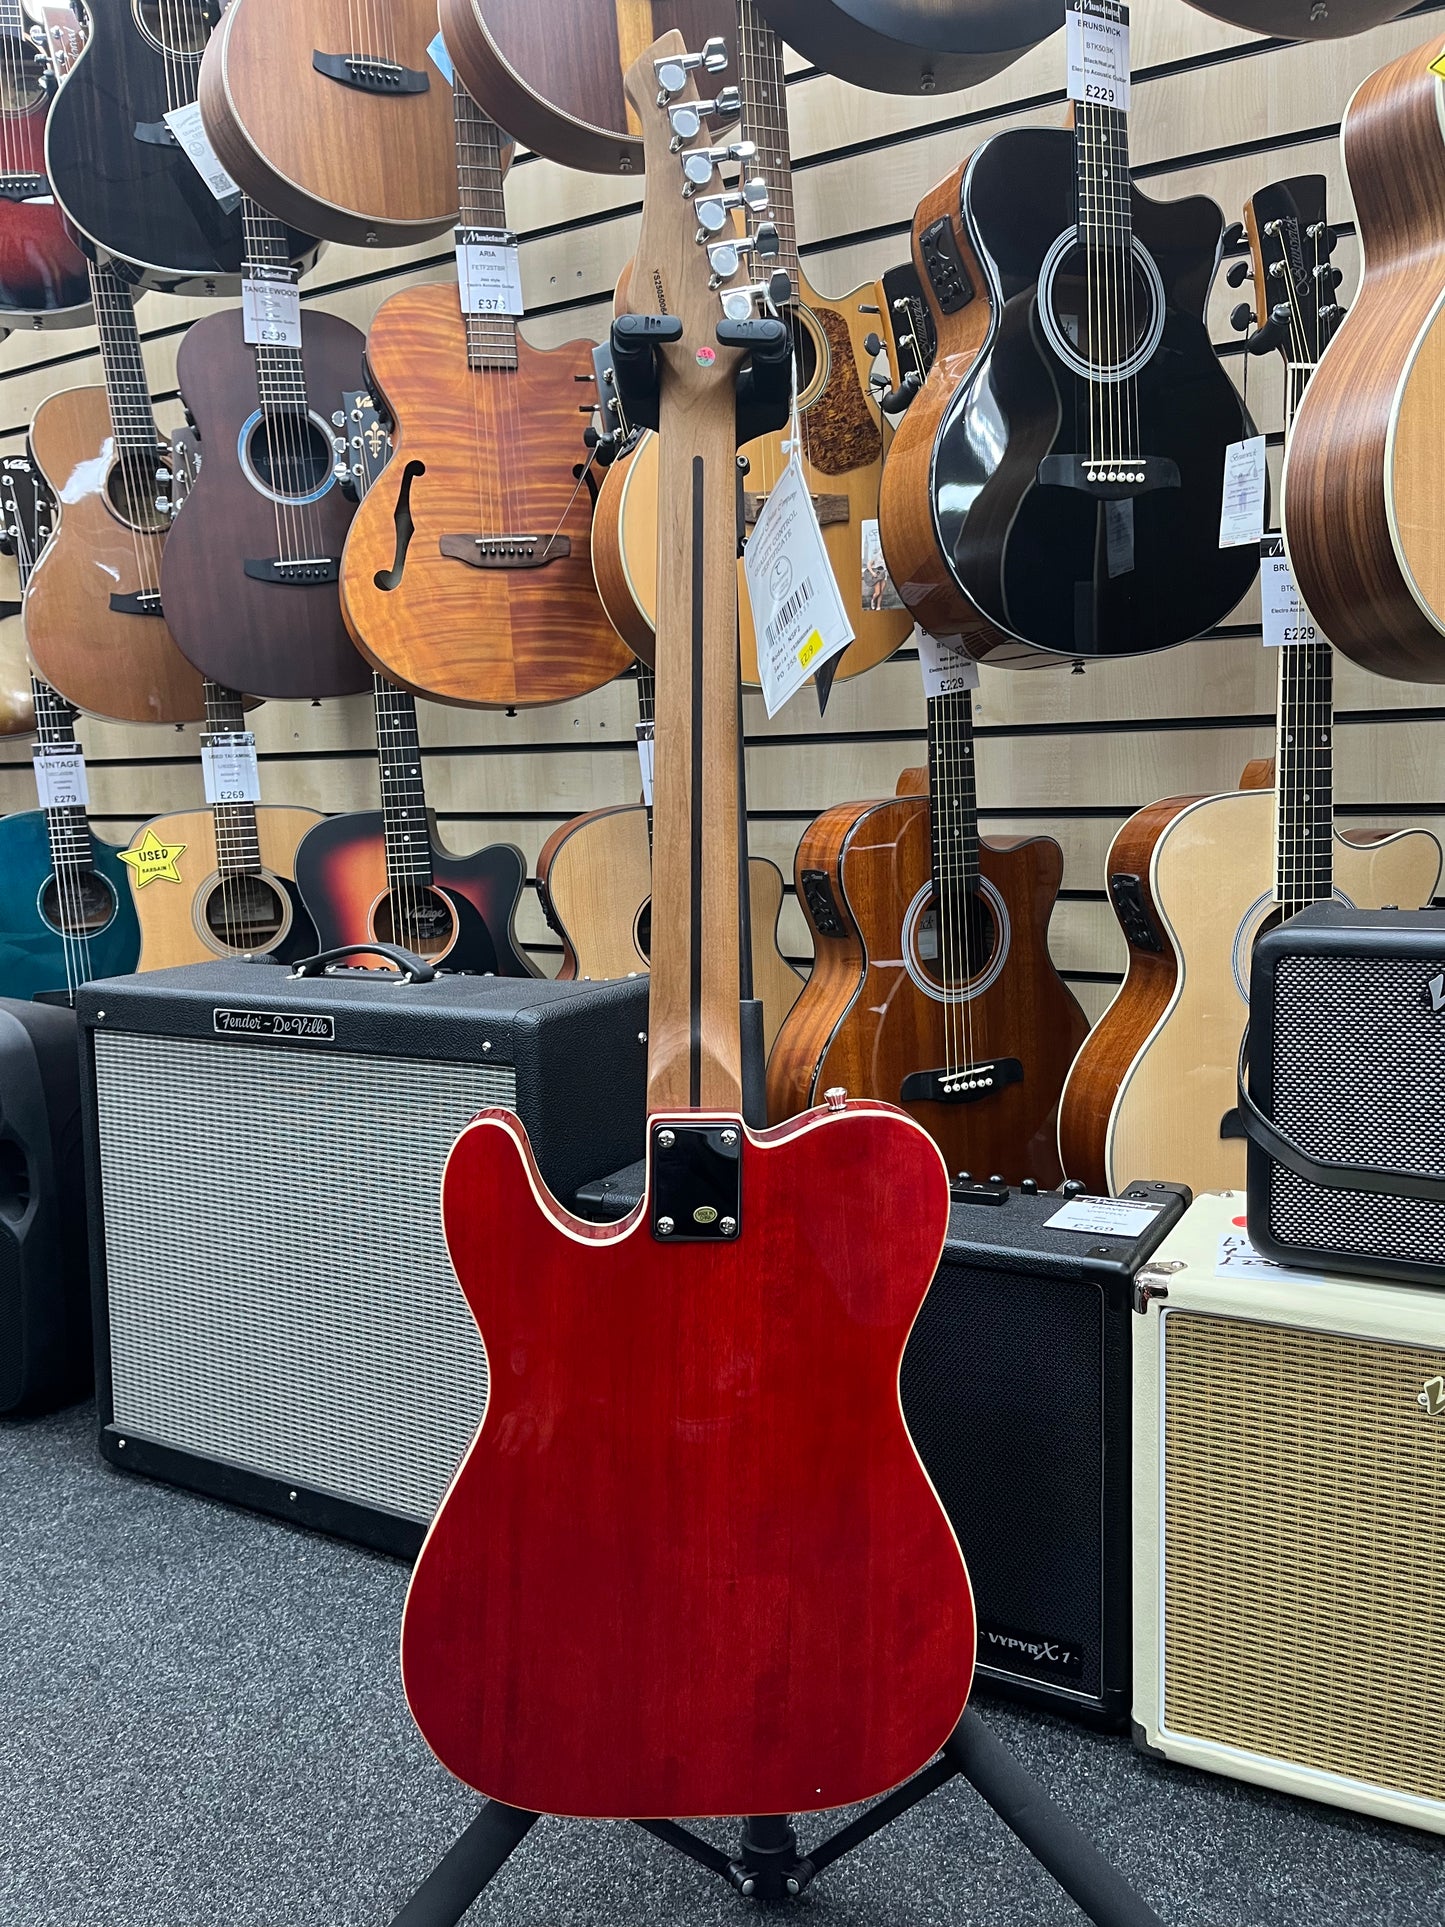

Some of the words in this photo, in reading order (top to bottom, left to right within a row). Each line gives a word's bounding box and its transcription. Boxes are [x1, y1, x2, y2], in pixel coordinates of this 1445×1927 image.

[1077, 19, 1121, 37] BRUNSWICK
[1086, 84, 1115, 102] £229
[244, 286, 298, 297] TANGLEWOOD
[772, 510, 798, 547] CONTROL
[1284, 626, 1315, 640] £229
[940, 677, 965, 692] £229
[40, 760, 80, 769] VINTAGE
[54, 794, 77, 804] £279
[220, 790, 245, 800] £269
[138, 848, 168, 862] USED
[219, 1012, 261, 1030] Fender
[1073, 1223, 1114, 1232] £269
